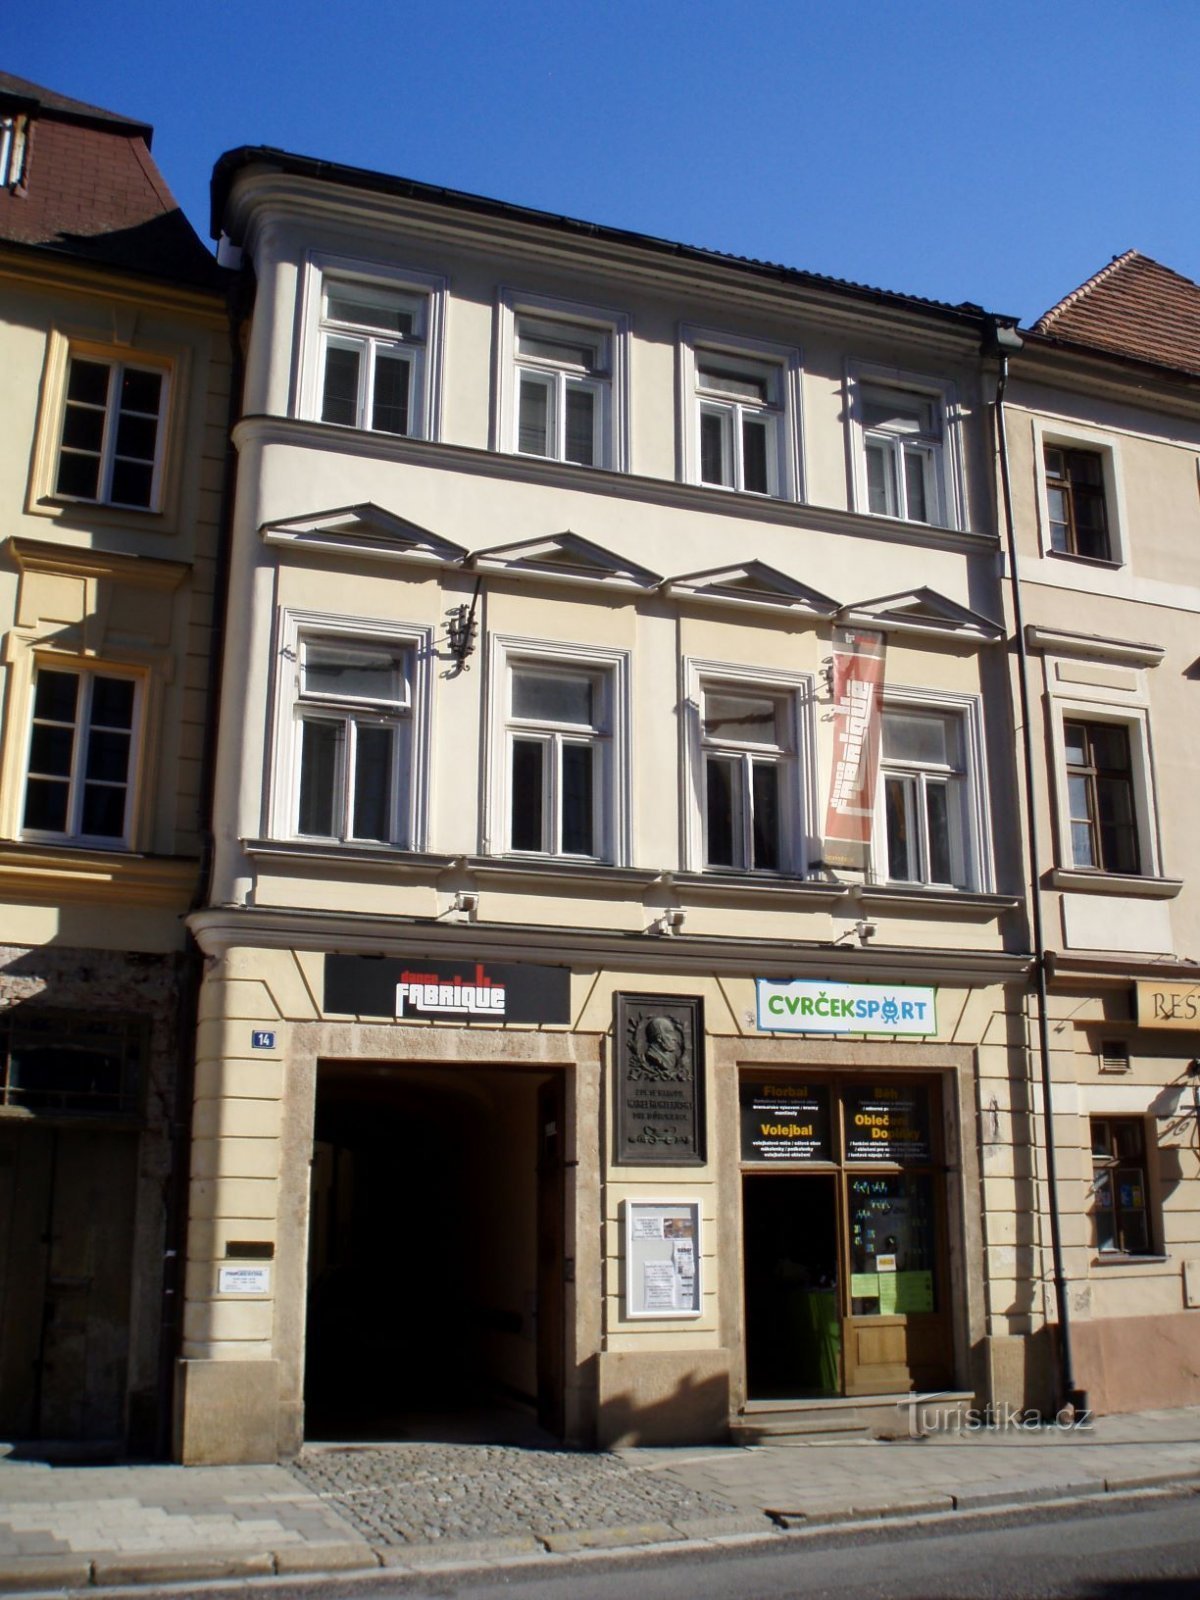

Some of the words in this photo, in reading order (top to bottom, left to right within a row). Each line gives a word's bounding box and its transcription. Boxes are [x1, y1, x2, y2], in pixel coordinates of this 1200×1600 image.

[1152, 992, 1200, 1020] RES
[258, 1033, 270, 1046] 14
[763, 1086, 808, 1097] Florbal
[761, 1124, 813, 1137] Volejbal
